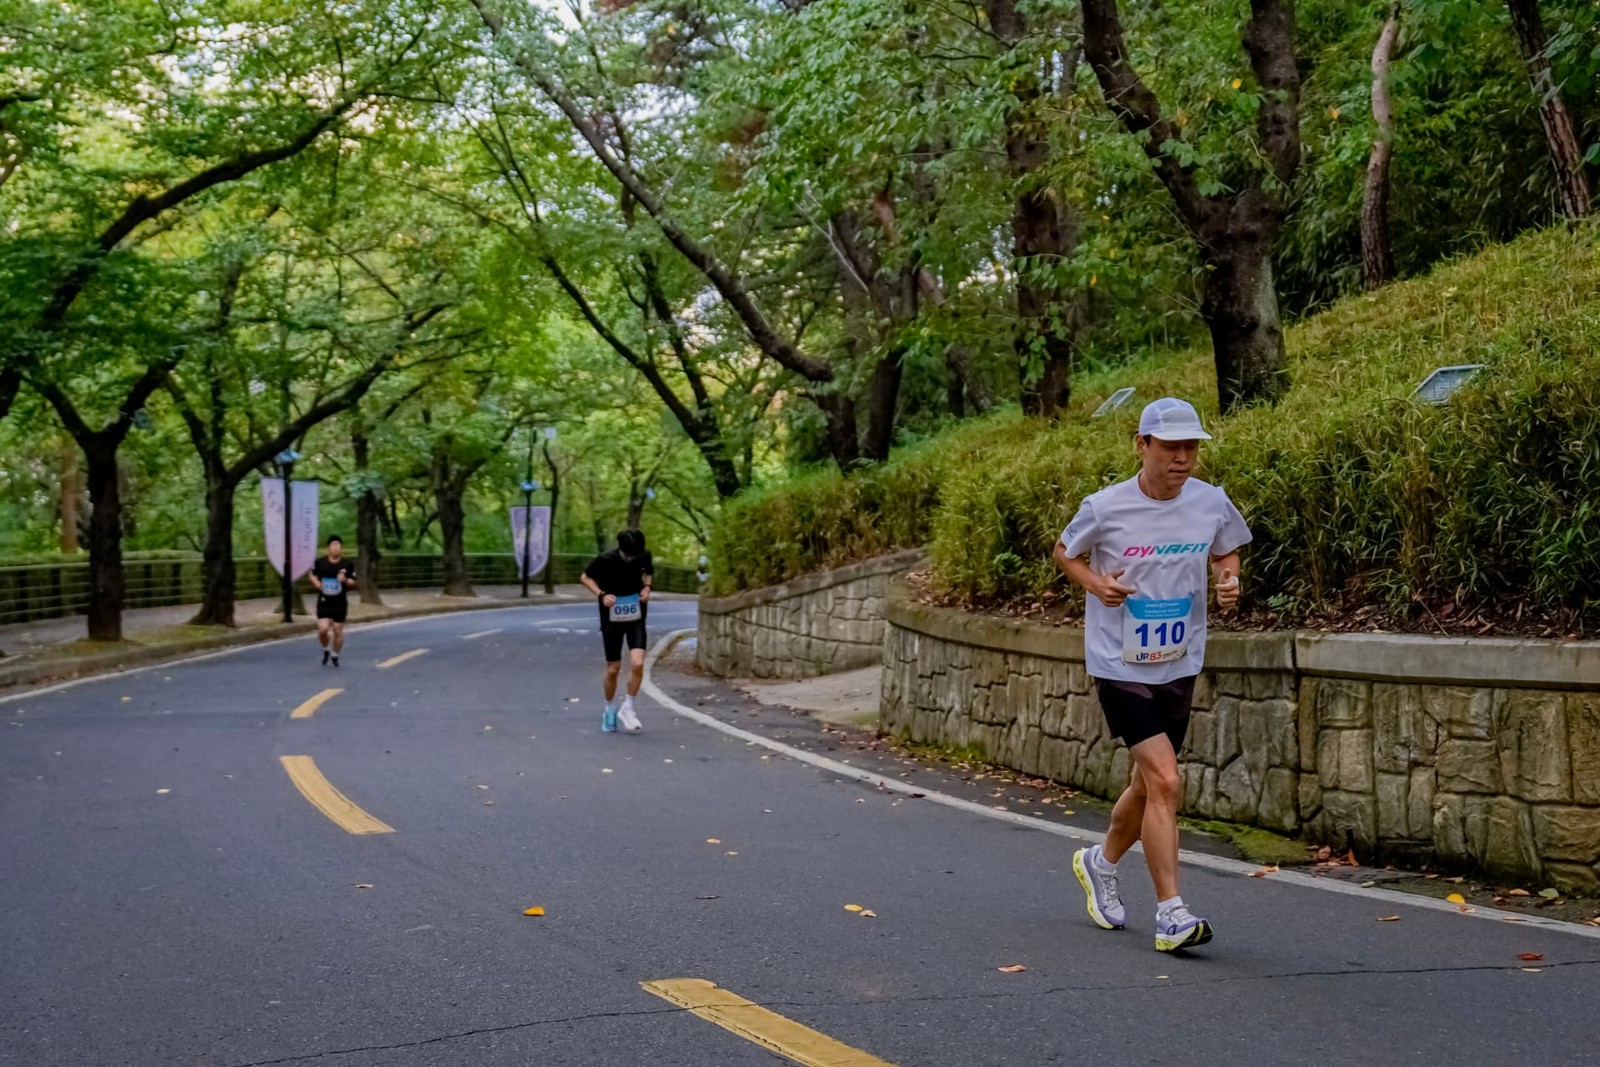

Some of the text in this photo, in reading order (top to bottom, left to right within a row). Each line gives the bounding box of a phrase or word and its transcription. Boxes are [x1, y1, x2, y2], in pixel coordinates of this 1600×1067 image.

[1122, 543, 1209, 558] DYNAFIT
[614, 604, 637, 615] 096
[1135, 620, 1185, 647] 110
